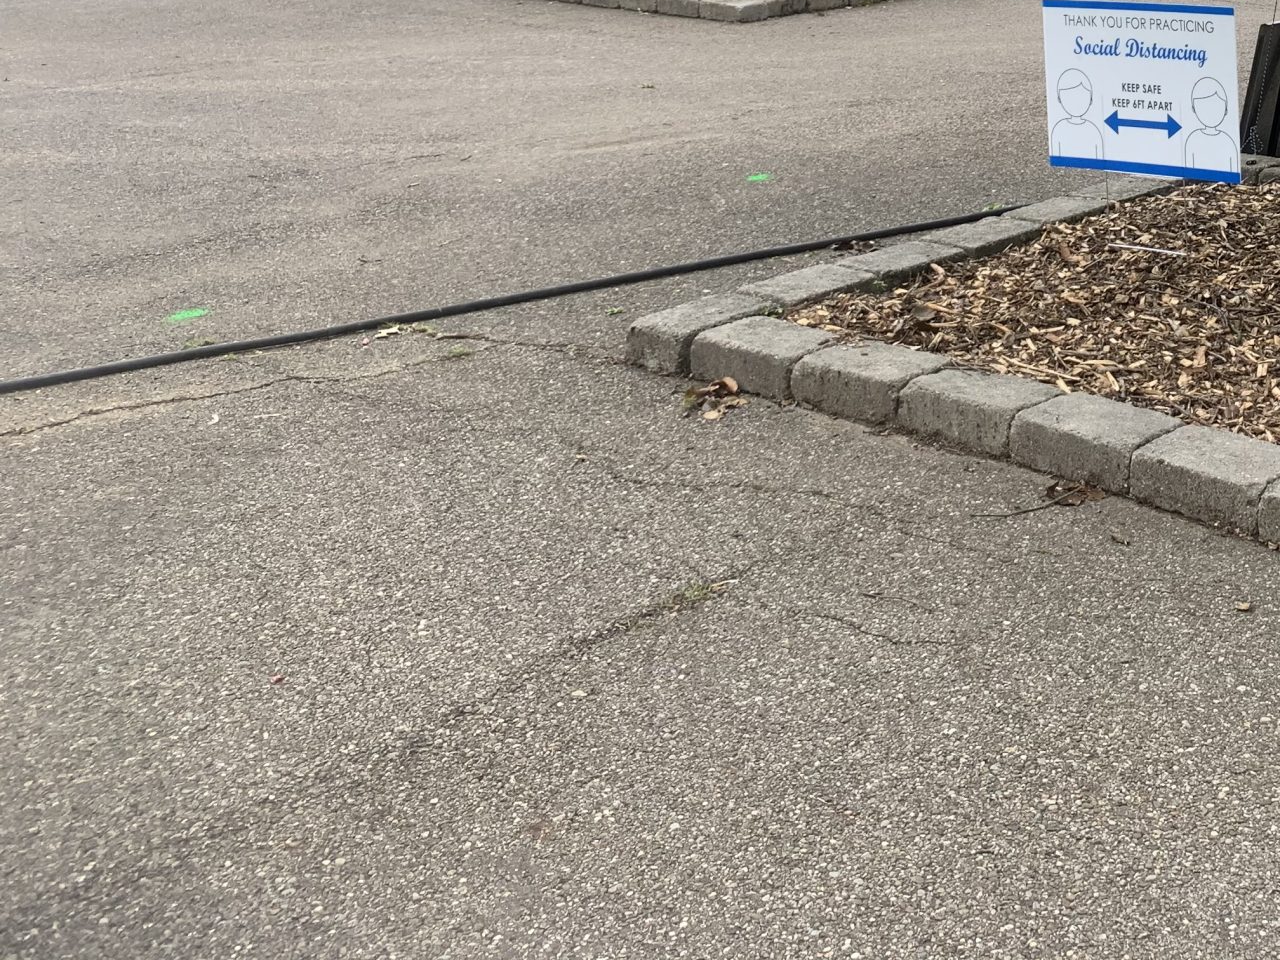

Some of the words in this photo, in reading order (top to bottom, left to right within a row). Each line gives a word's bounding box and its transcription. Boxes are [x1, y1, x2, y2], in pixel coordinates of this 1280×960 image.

[1063, 14, 1098, 27] THANK
[1100, 16, 1123, 28] YOU
[1125, 17, 1147, 30] FOR
[1149, 18, 1215, 34] PRACTICING
[1073, 35, 1121, 57] Social
[1125, 38, 1208, 68] Distancing
[1121, 82, 1140, 93] KEEP
[1142, 83, 1162, 94] SAFE
[1112, 98, 1130, 108] KEEP
[1132, 99, 1145, 109] 6FT
[1147, 100, 1173, 111] APART
